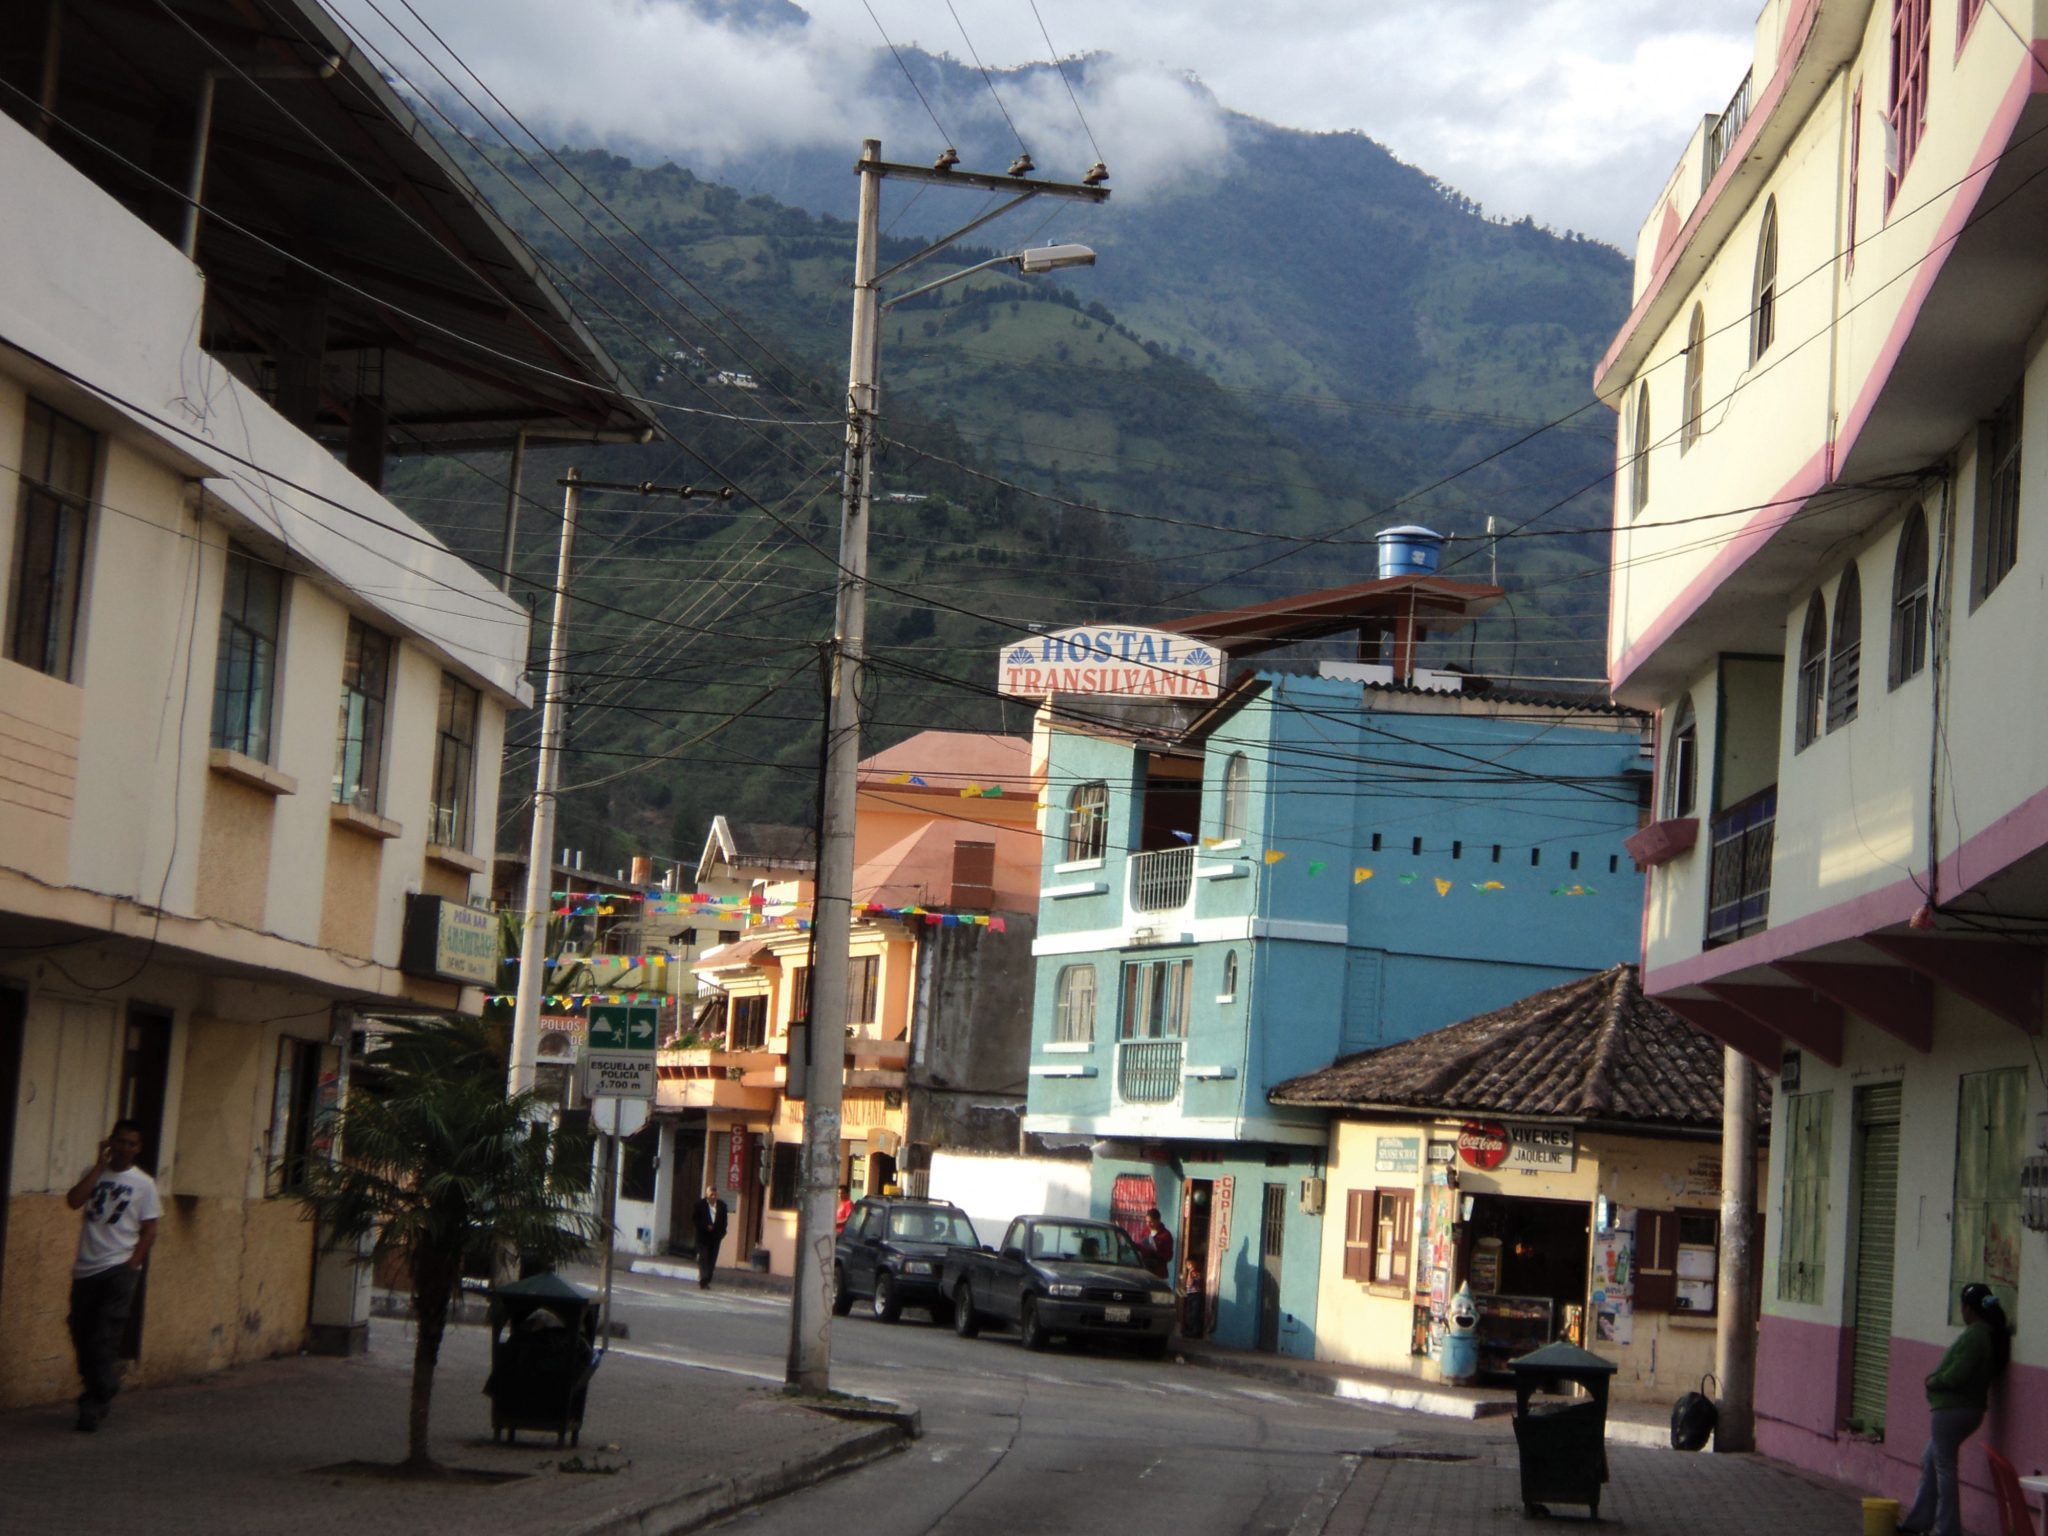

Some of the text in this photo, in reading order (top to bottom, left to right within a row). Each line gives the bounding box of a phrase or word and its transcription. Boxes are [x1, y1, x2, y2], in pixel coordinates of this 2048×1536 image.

[1041, 631, 1178, 665] HOSTAL
[1006, 666, 1210, 696] TRANSILVANIA
[541, 1019, 580, 1031] POLLOS
[591, 1061, 651, 1071] ESCUELA DE
[601, 1069, 640, 1080] POLICIA
[600, 1080, 628, 1089] 1.700
[1512, 1127, 1570, 1146] VIVERES
[730, 1126, 743, 1183] COPIAS
[1514, 1148, 1563, 1165] JAQUELINE
[1219, 1176, 1232, 1249] COPIAS
